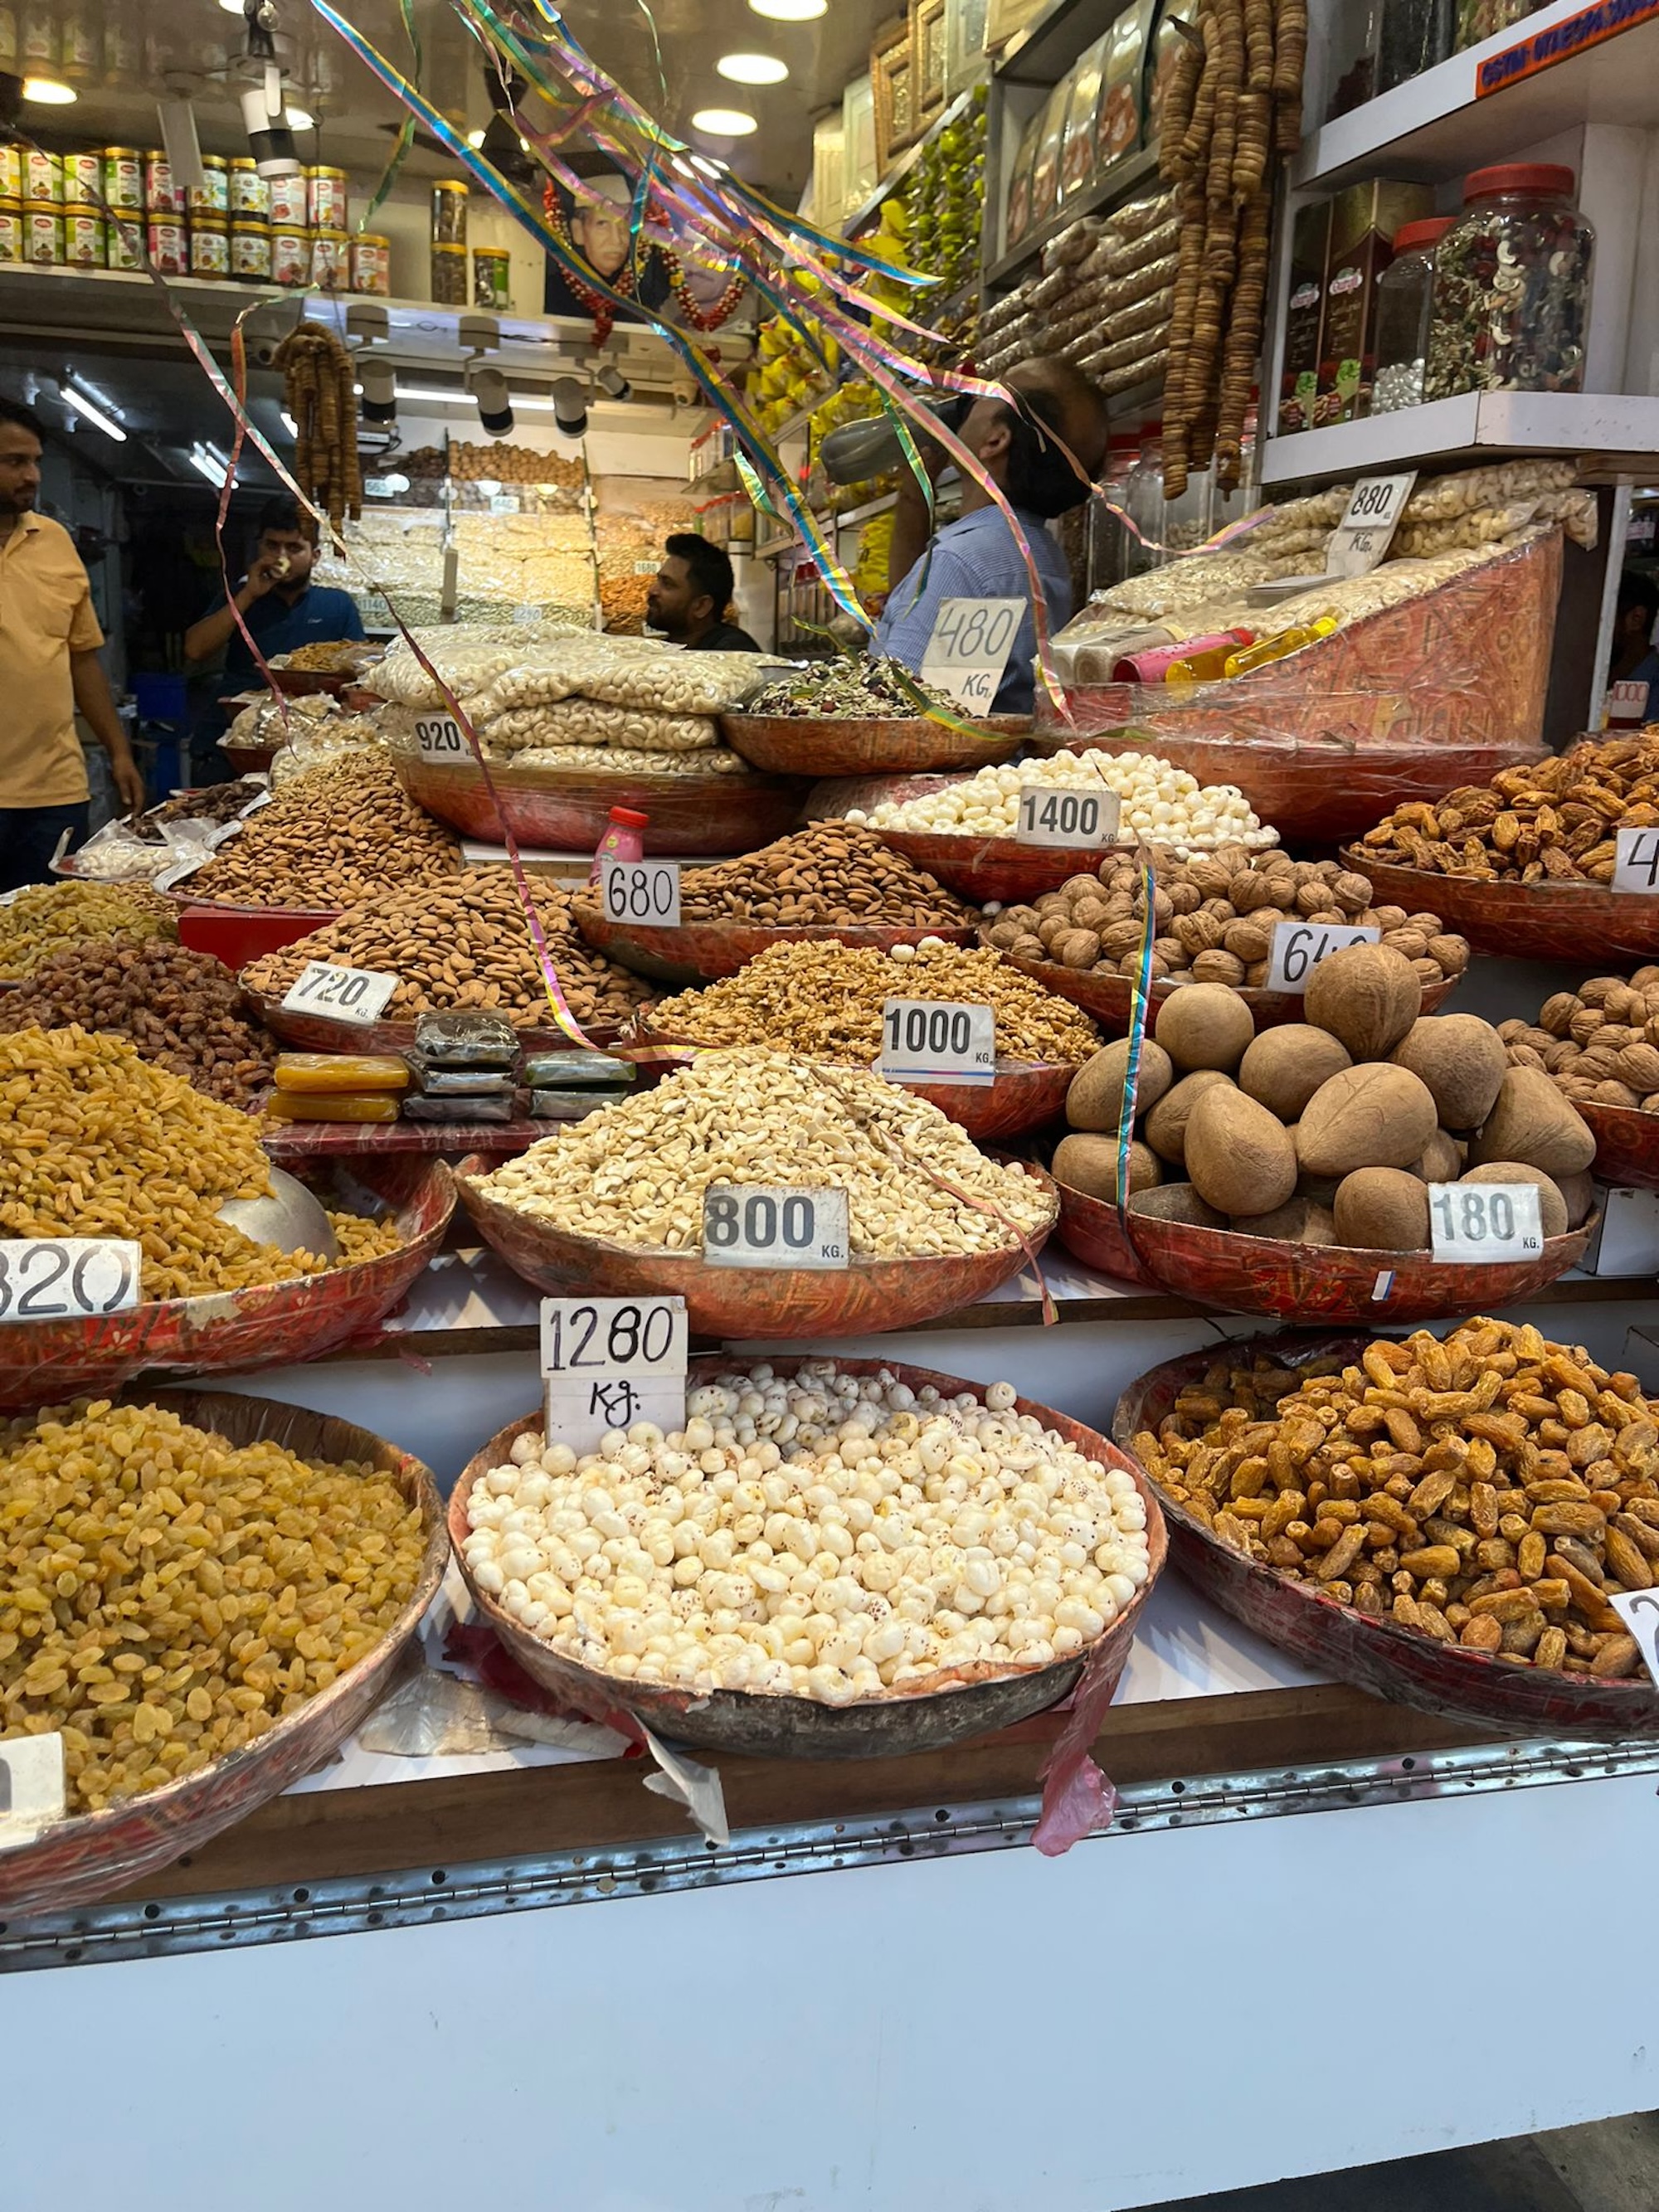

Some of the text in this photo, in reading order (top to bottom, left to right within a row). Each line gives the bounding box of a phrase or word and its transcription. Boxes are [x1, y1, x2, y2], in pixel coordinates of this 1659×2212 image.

[1350, 484, 1394, 516] 880
[938, 608, 1014, 658] 480
[415, 721, 461, 751] 920
[1023, 795, 1099, 835] 1400
[609, 867, 674, 917] 680
[298, 967, 370, 1006] 720
[885, 1008, 971, 1055] 1000
[706, 1194, 844, 1258] 800 KG.
[1433, 1192, 1540, 1249] 180 KG.
[547, 1305, 674, 1371] 1280
